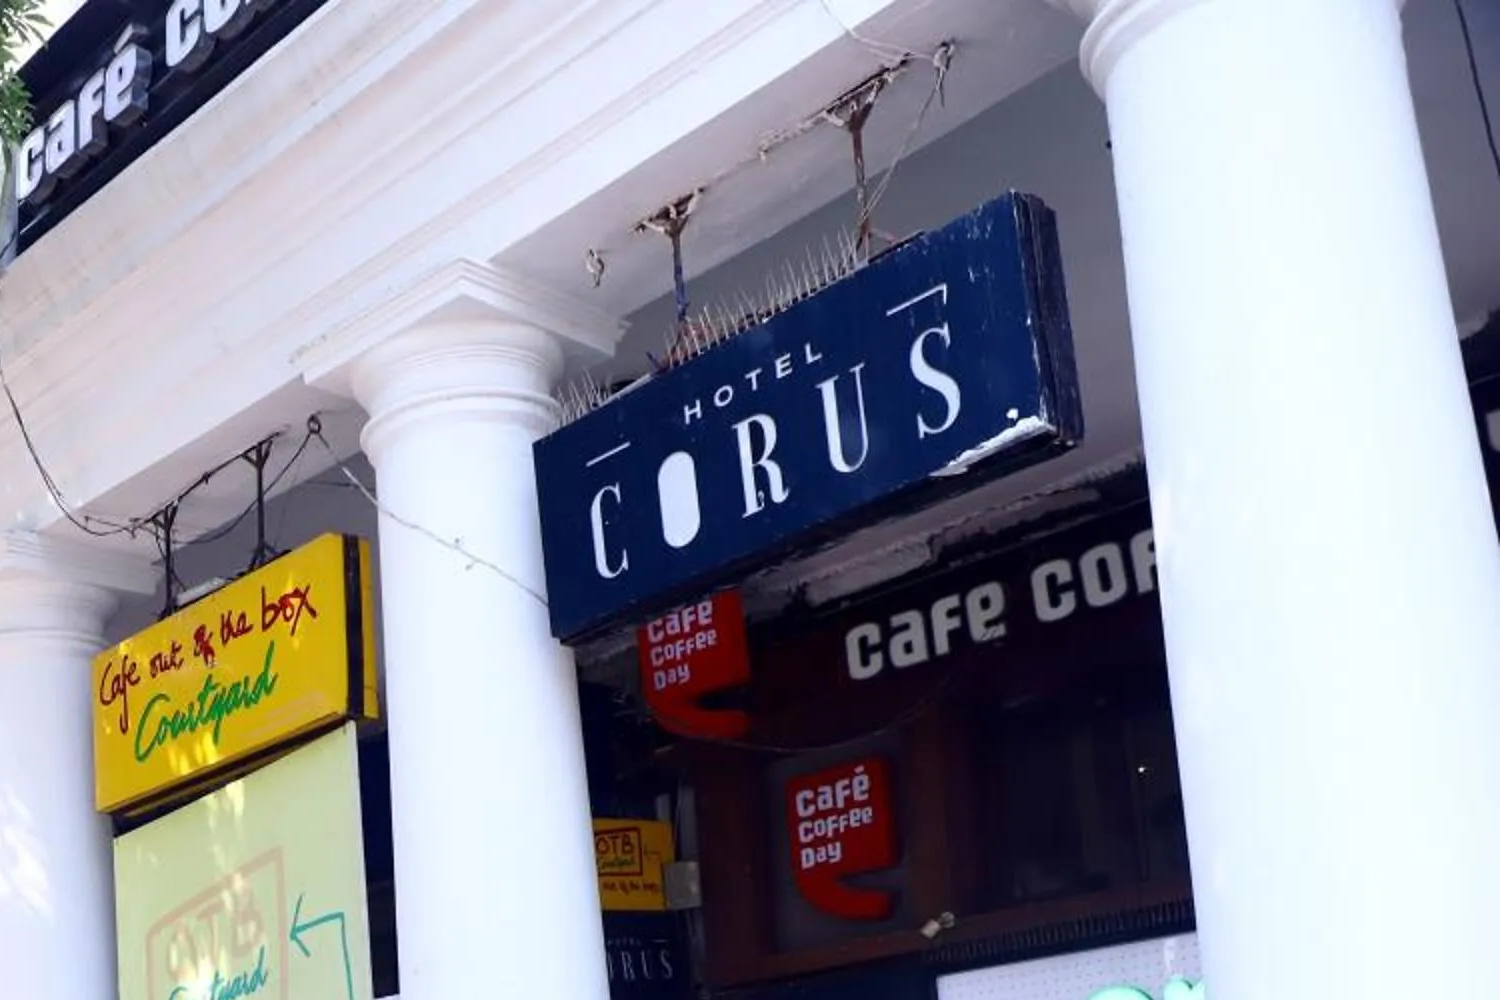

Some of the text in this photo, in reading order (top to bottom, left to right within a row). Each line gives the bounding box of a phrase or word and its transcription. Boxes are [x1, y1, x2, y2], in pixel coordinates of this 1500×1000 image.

[684, 344, 823, 425] HOTEL
[589, 322, 961, 580] CORUS
[1029, 527, 1159, 624] COF
[99, 654, 140, 735] Cafe
[150, 640, 184, 678] out
[220, 608, 253, 646] the
[261, 585, 318, 637] box
[134, 640, 279, 763] Courtyard
[653, 663, 691, 690] Day
[801, 842, 842, 870] Day
